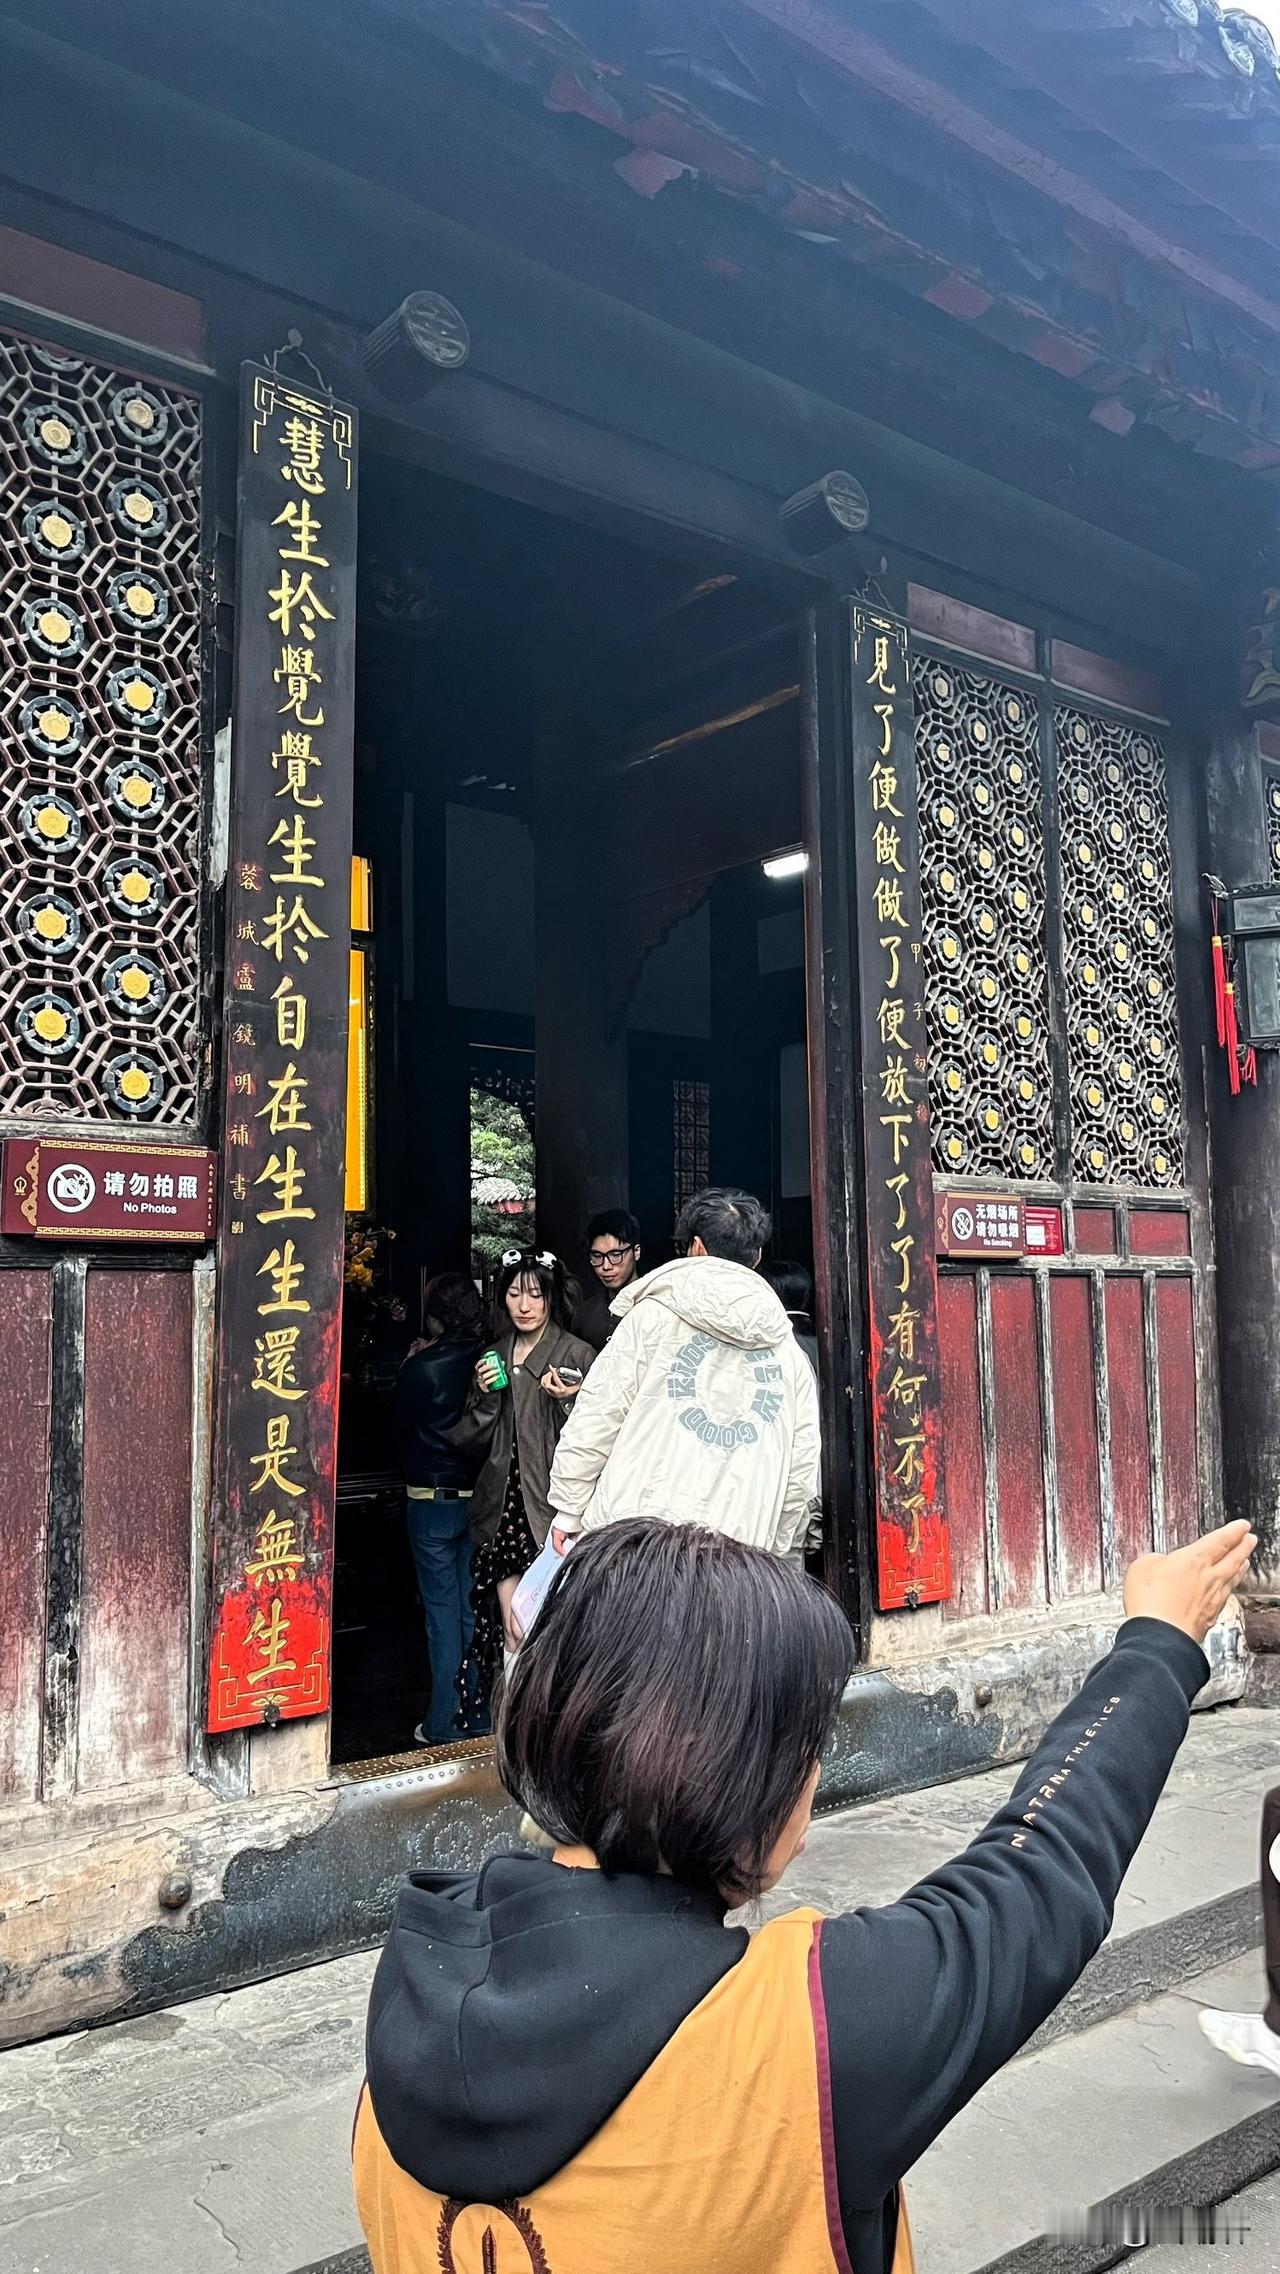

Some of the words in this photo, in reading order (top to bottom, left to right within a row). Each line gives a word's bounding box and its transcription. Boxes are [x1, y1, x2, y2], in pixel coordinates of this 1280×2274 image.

[103, 1171, 198, 1199] 请勿拍照
[123, 1202, 139, 1213] No
[140, 1203, 178, 1215] Photos
[975, 1203, 1018, 1221] 无烟场所
[975, 1221, 1020, 1239] 请勿吸烟
[667, 1331, 720, 1398] KIDS
[678, 1406, 759, 1450] GOOD
